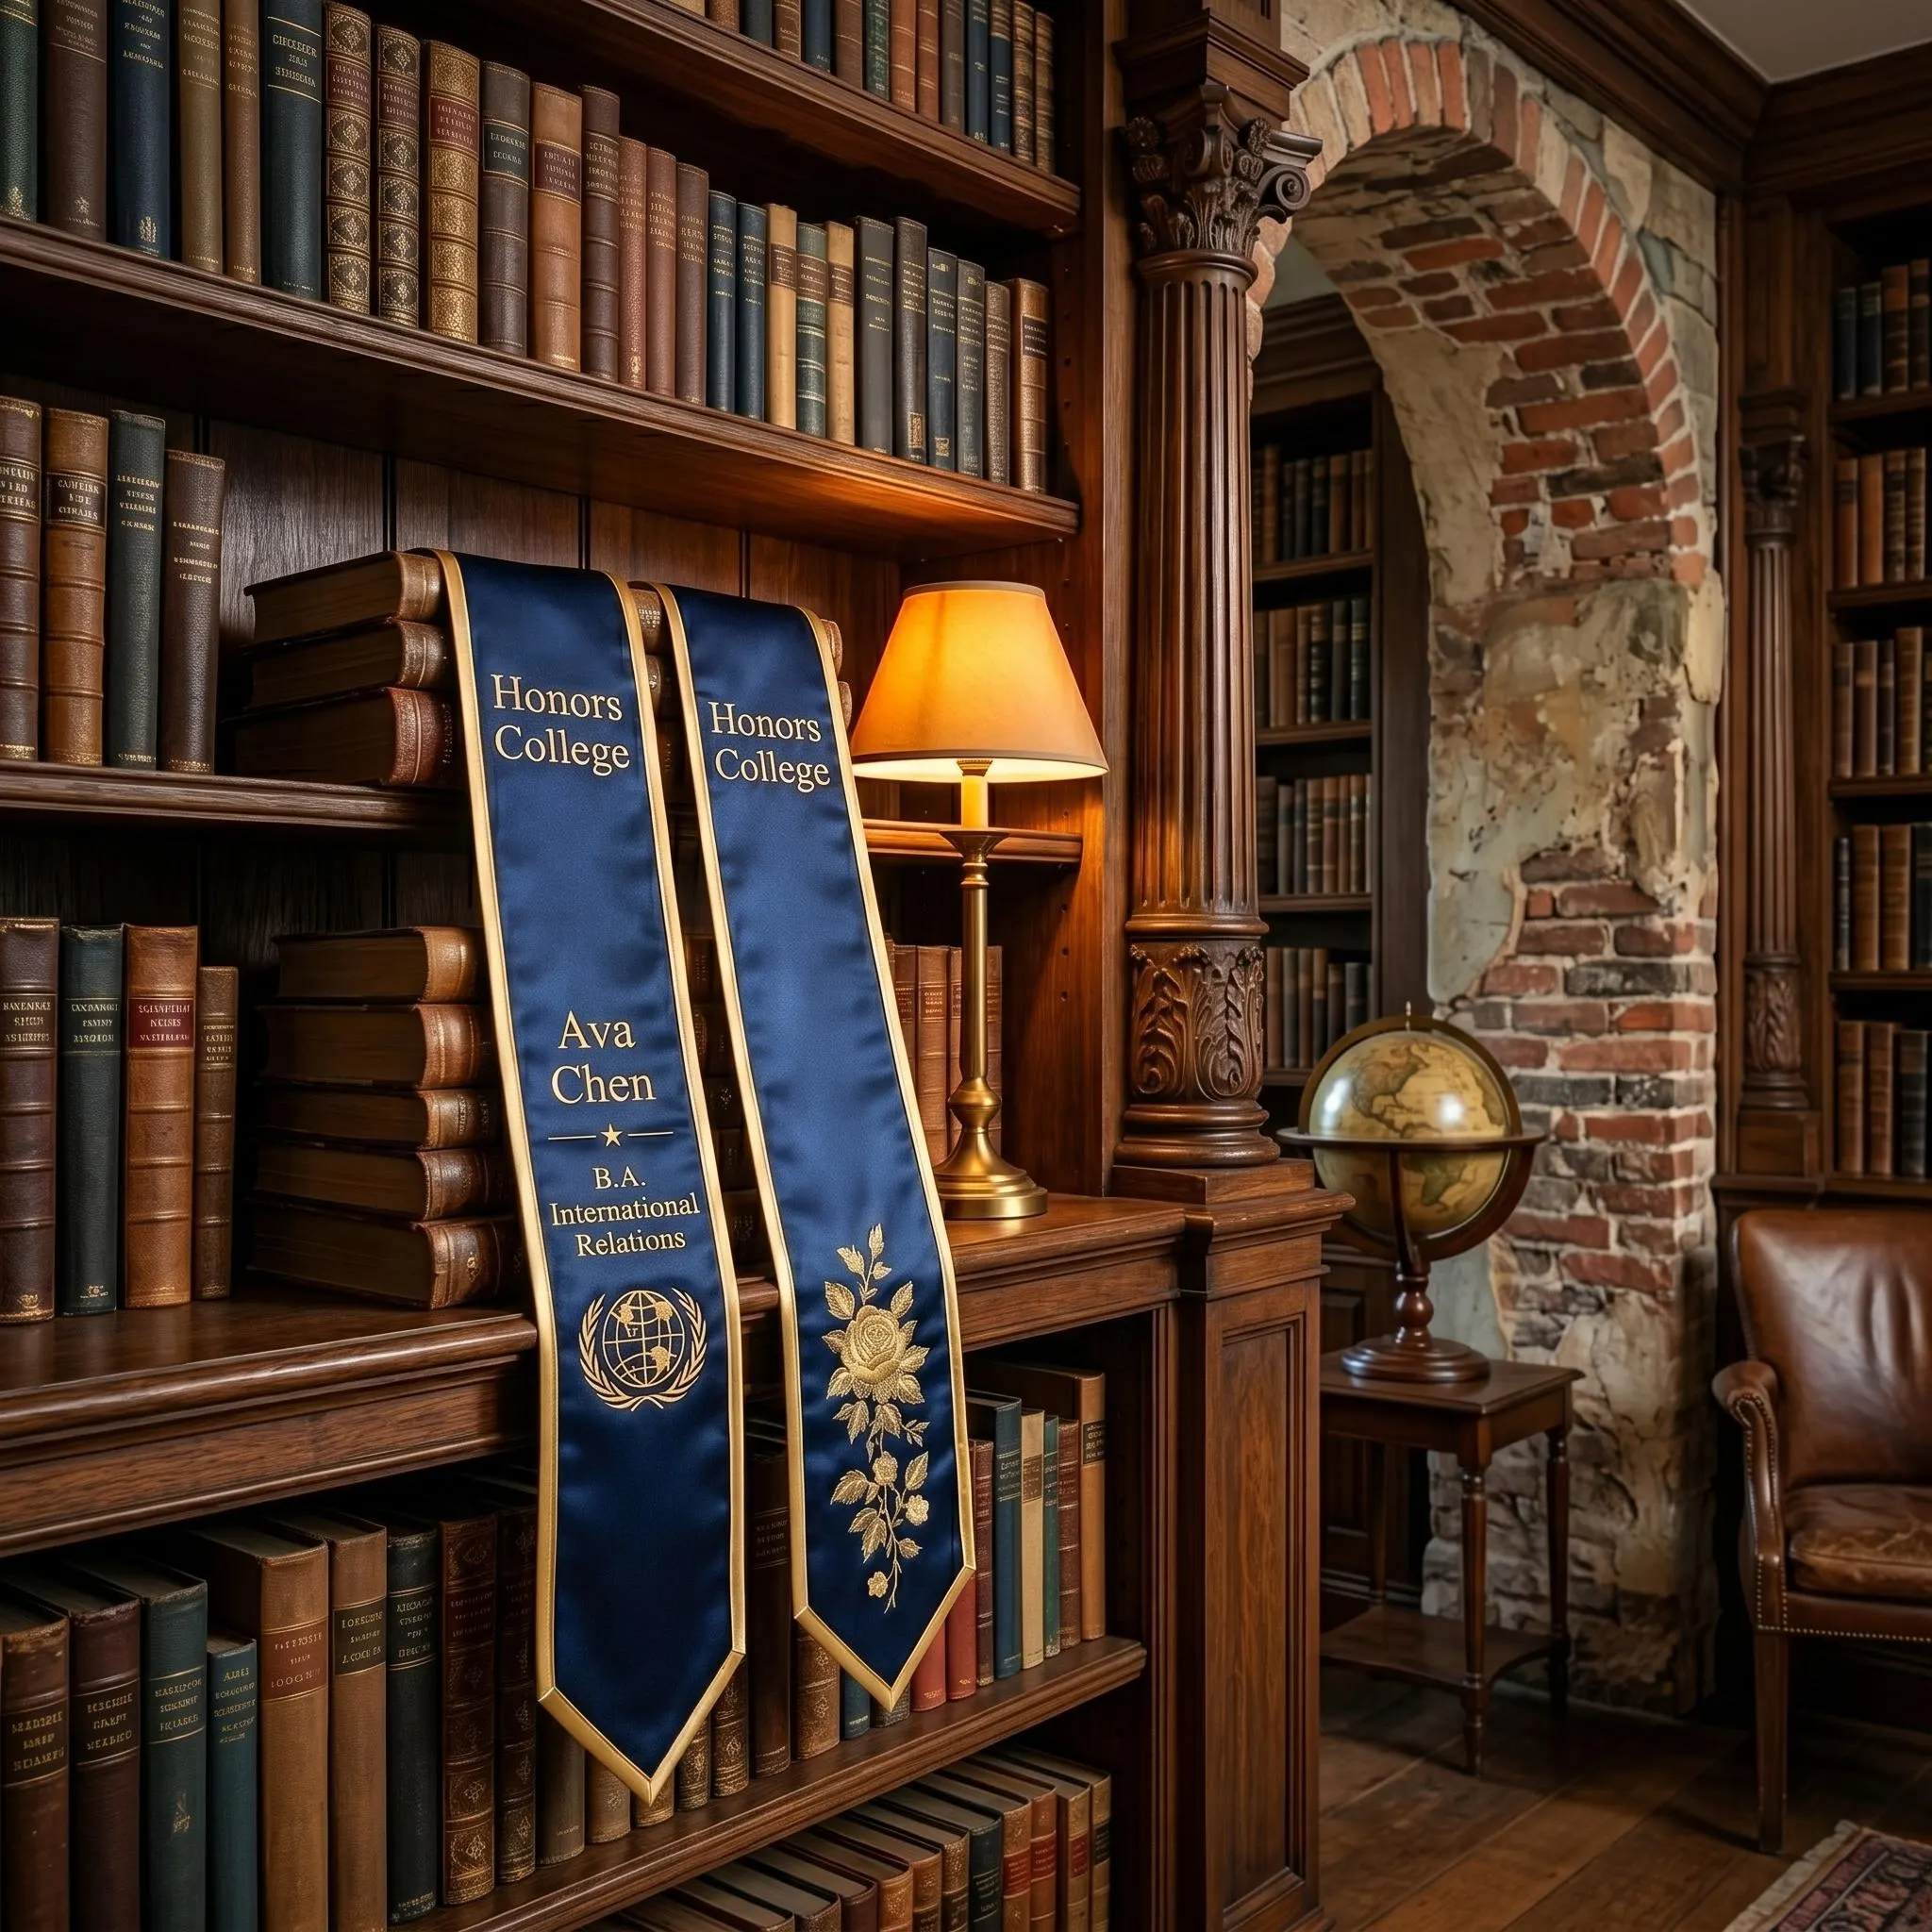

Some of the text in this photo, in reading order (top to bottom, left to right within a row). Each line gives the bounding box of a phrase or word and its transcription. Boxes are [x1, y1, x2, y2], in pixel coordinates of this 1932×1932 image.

[491, 674, 623, 721] Honors
[708, 701, 822, 742] Honors
[494, 724, 630, 776] College
[714, 748, 831, 793] College
[558, 1010, 636, 1049] Ava
[551, 1064, 657, 1104] Chen
[592, 1166, 646, 1190] B.A.
[549, 1192, 700, 1226] International
[575, 1230, 686, 1257] Relations
